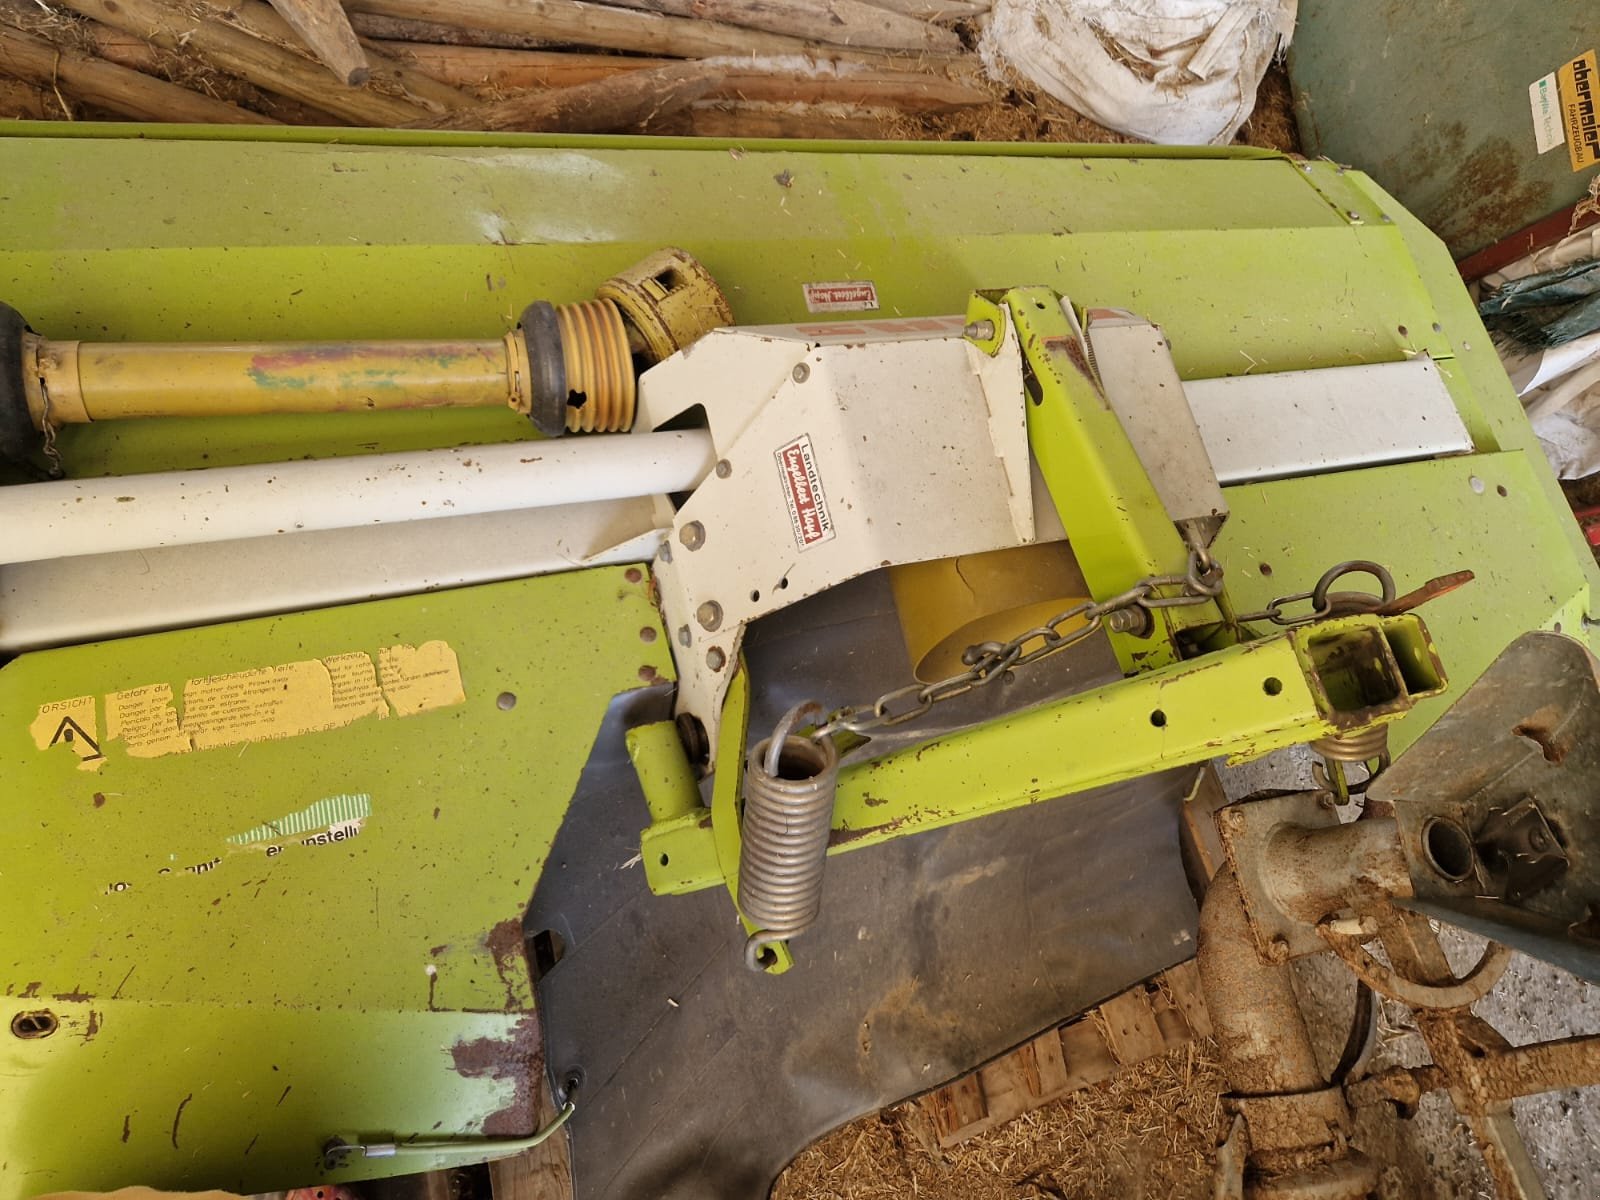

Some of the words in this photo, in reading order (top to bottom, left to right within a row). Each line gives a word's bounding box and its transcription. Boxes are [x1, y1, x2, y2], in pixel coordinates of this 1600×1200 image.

[1568, 103, 1584, 163] FAHRZEUGBAU
[1573, 59, 1600, 160] obermaier
[786, 447, 812, 505] Engelbert
[801, 443, 829, 532] Landtechnik
[39, 697, 94, 714] ORSICHT
[116, 688, 150, 701] Gefahr
